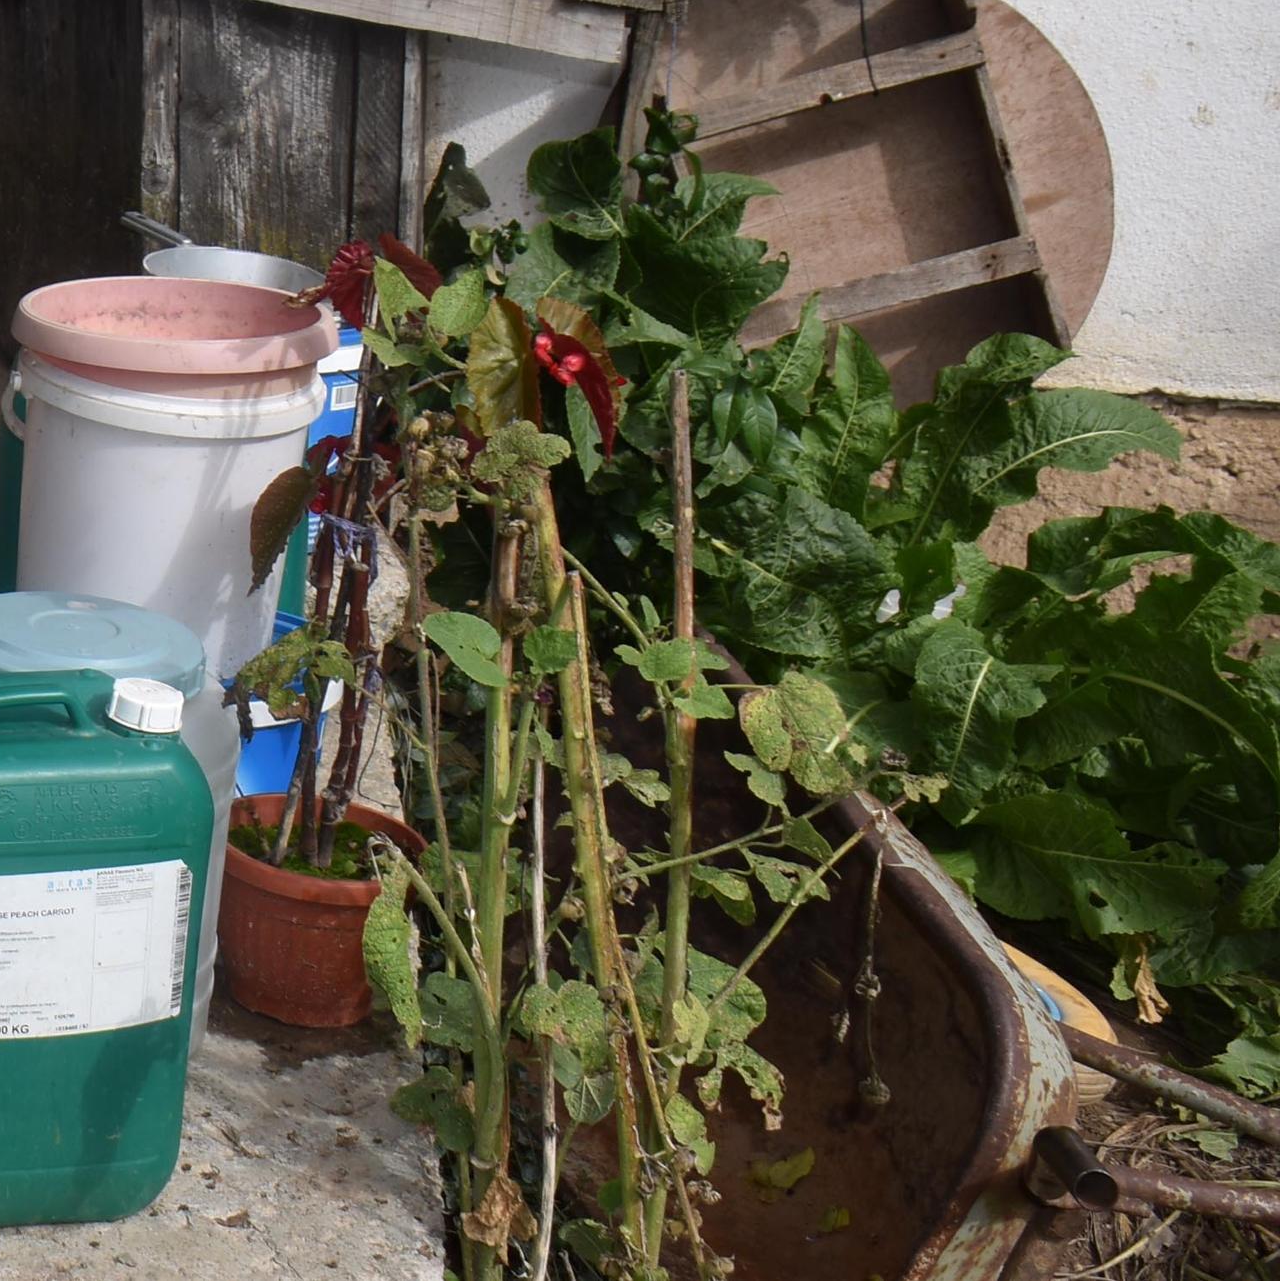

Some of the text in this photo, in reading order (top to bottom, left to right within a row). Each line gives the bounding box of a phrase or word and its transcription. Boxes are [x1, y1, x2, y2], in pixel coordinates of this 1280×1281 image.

[10, 909, 39, 918] PEACH
[40, 908, 75, 917] CARROT
[11, 1024, 30, 1035] KG
